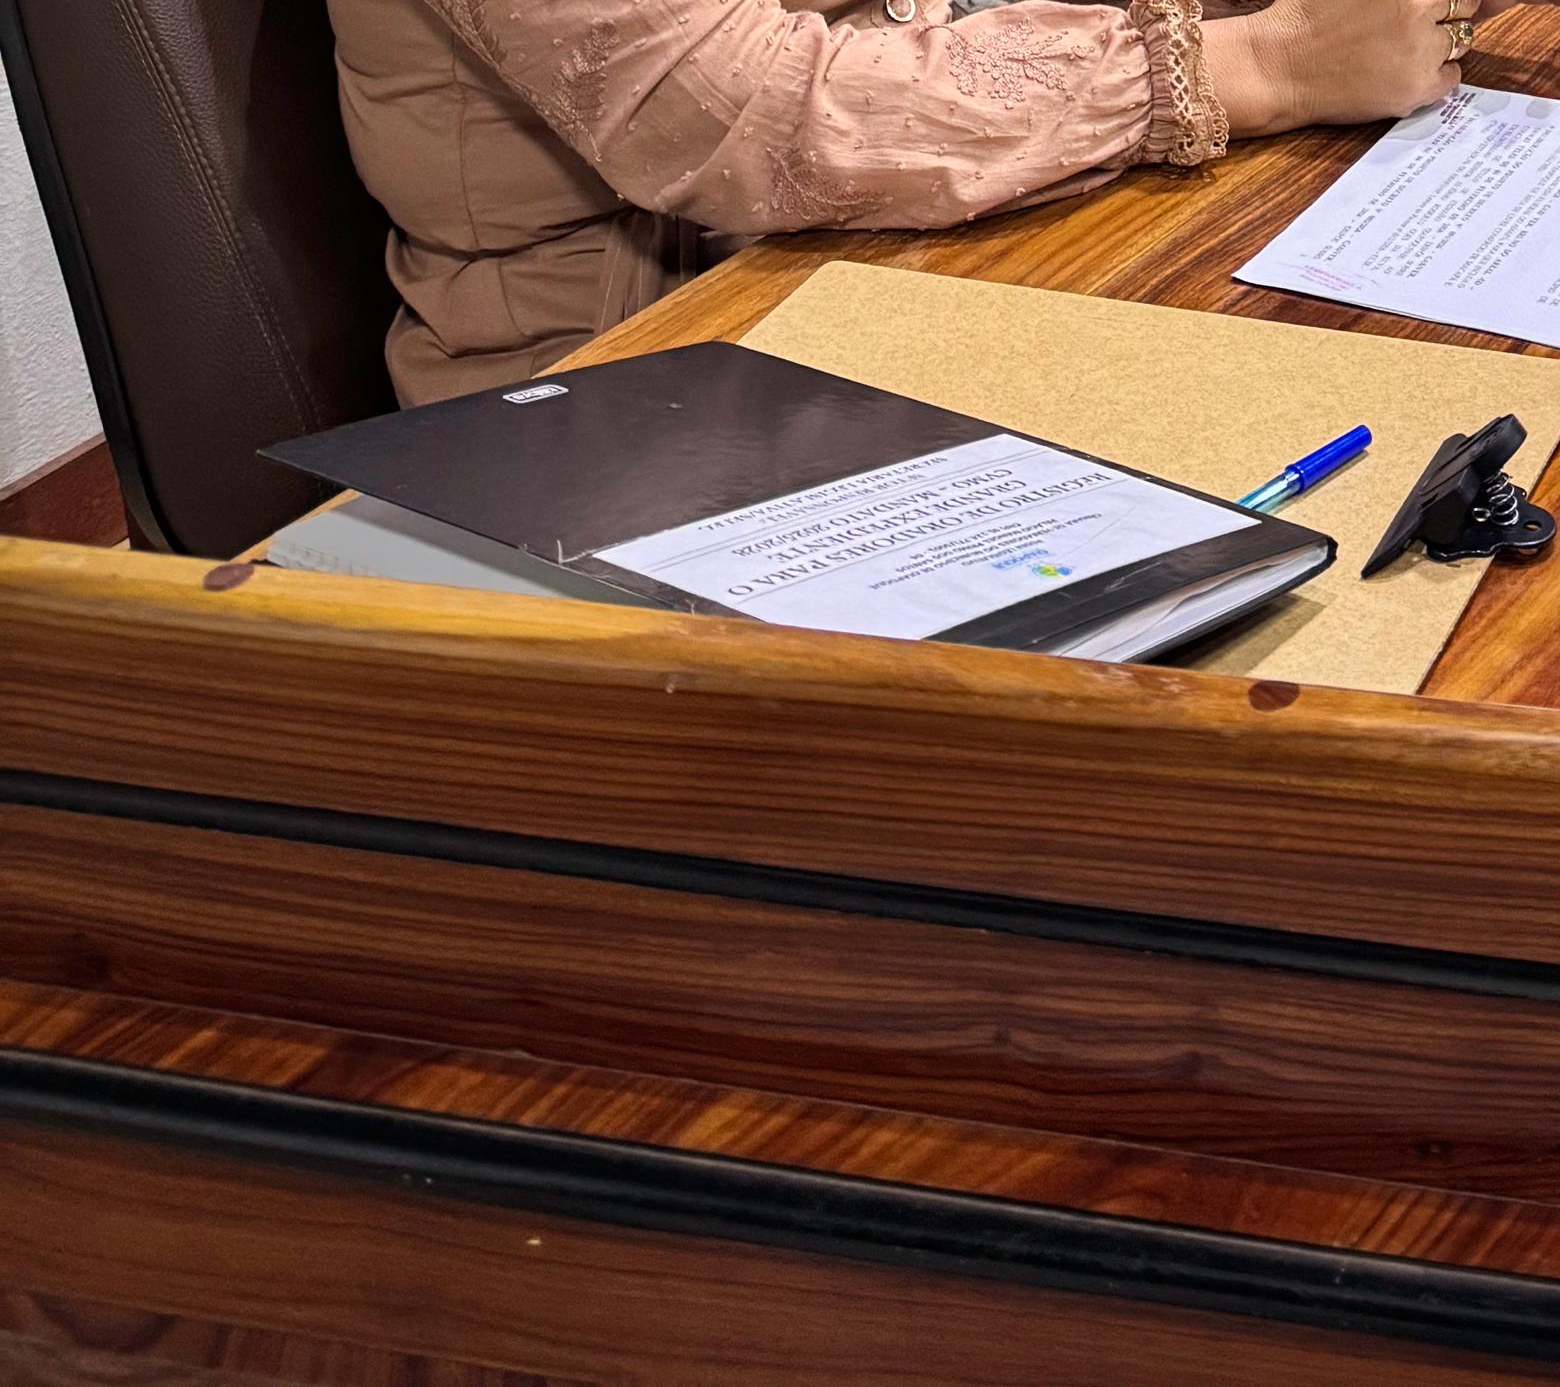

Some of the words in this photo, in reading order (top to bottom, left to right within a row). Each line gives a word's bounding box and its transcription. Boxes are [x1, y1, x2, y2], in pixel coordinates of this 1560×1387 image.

[923, 479, 1029, 512] GRANDE
[993, 471, 1112, 510] REGISTRO
[825, 490, 942, 526] MANDATO
[956, 504, 1004, 520] DE
[726, 523, 834, 557] 2025/2028
[822, 515, 969, 563] ORADORES
[752, 559, 832, 585] PARA
[721, 583, 758, 596] O
